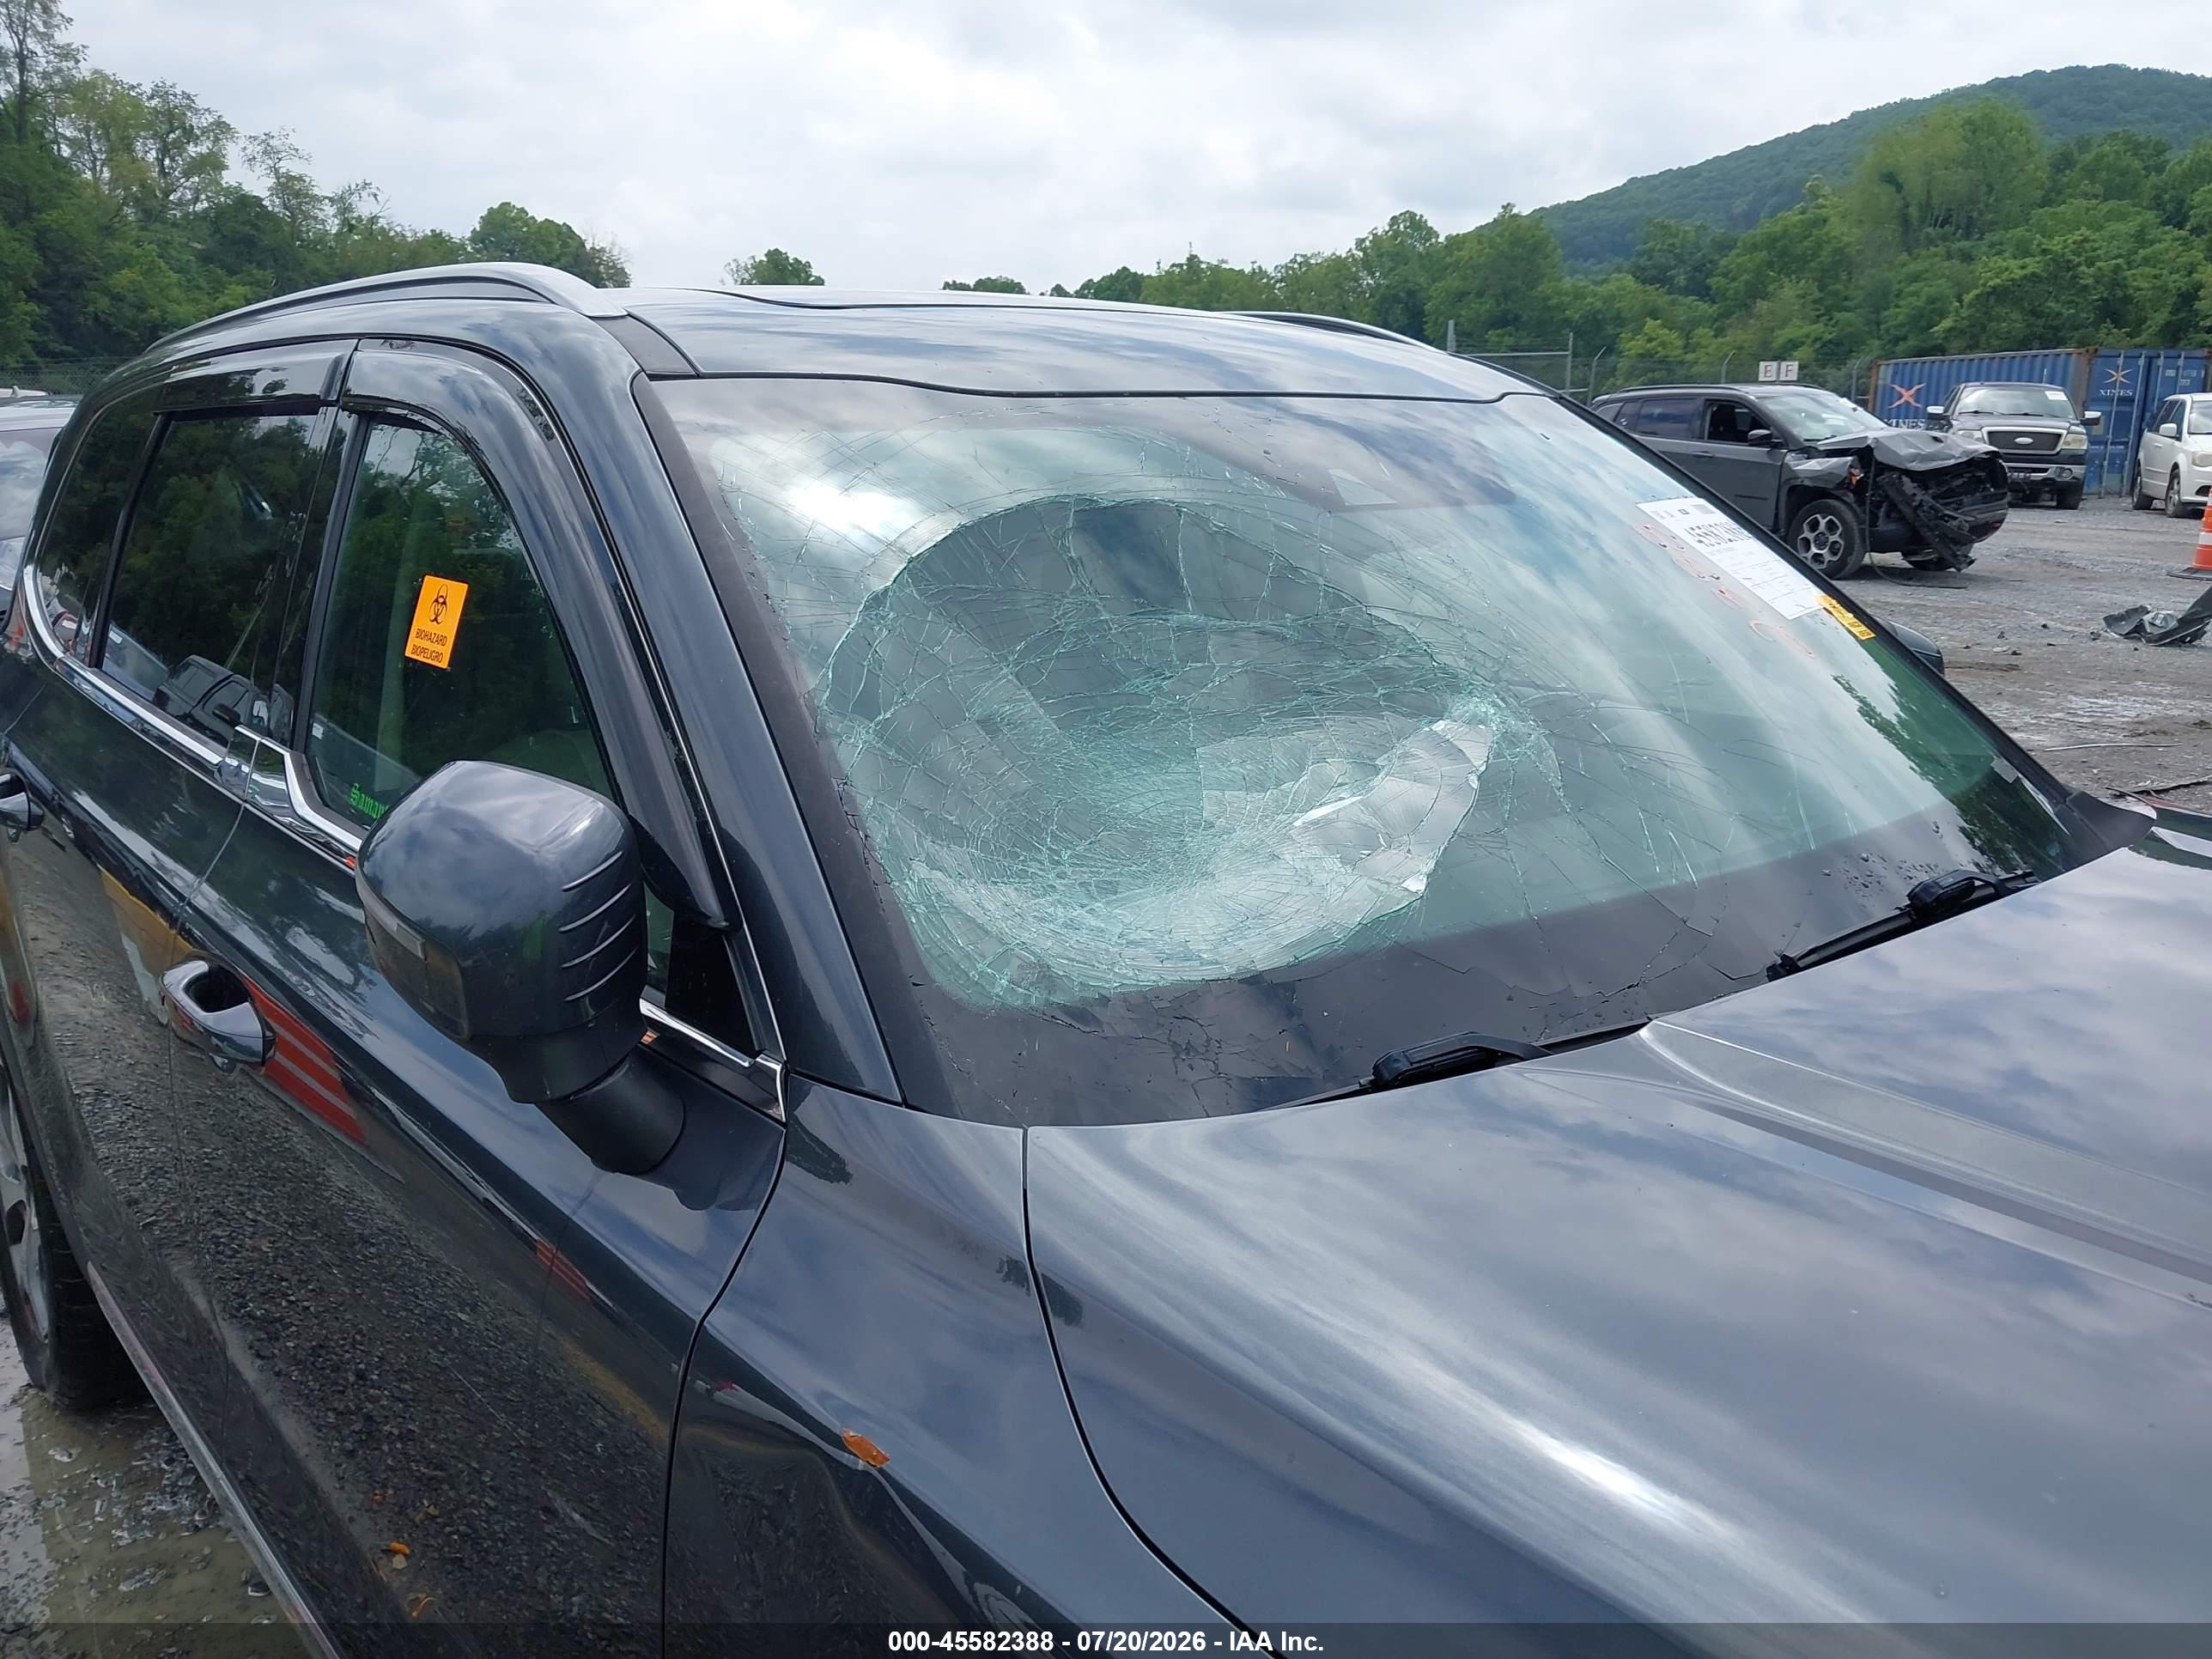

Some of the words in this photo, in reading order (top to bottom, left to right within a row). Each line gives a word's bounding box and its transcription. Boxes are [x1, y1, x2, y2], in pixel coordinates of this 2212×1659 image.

[1764, 364, 1773, 378] E
[1785, 364, 1794, 378] F
[416, 629, 447, 646] BIOHAZARD
[410, 645, 444, 663] BIOPELIGRO
